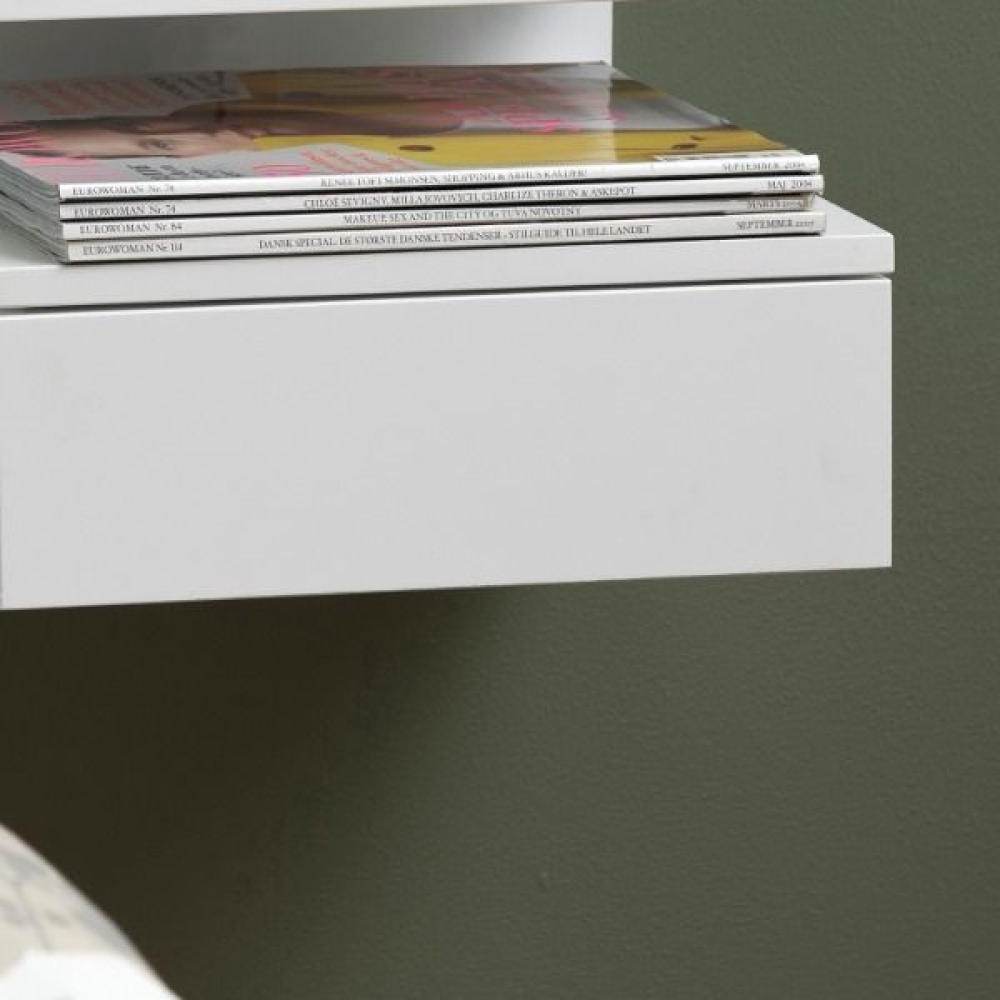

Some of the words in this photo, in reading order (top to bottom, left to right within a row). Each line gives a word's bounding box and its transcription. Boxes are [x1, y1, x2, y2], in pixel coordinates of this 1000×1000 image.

[722, 162, 779, 171] SEPTEMBER
[73, 186, 144, 196] EUROWOMAN
[391, 194, 422, 205] MILLA
[482, 189, 534, 202] CHARLIZE
[537, 188, 579, 199] THERON
[590, 186, 637, 196] ASKEPOT
[74, 205, 145, 217] EUROWOMAN
[390, 213, 407, 222] SEX
[410, 211, 432, 221] AND
[434, 211, 454, 220] THE
[455, 209, 482, 219] CITY
[502, 208, 529, 217] TUVA
[529, 206, 581, 216] NOVOTNY
[80, 223, 150, 234] EUROWOMAN
[736, 219, 793, 230] SEPTEMBER
[259, 238, 292, 249] DANSK
[399, 233, 440, 244] DANSKE
[441, 230, 501, 243] TENDENSER
[582, 226, 608, 236] HELE
[609, 224, 651, 235] LANDET
[83, 243, 156, 255] EUROWOMAN
